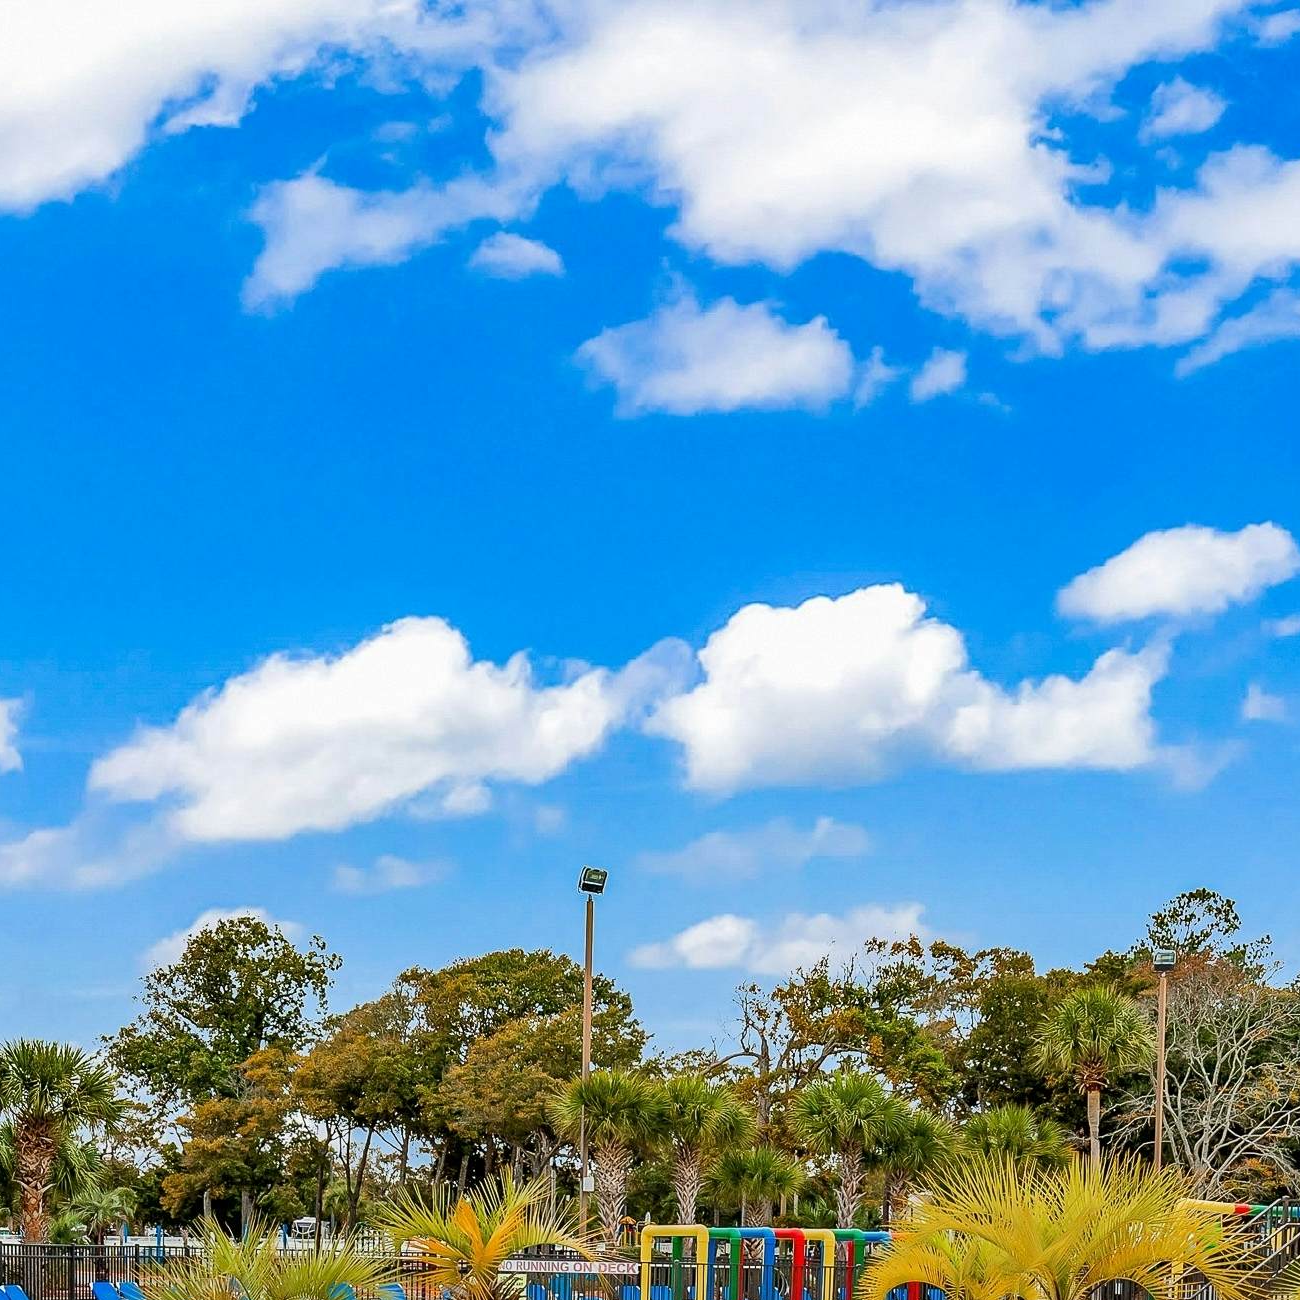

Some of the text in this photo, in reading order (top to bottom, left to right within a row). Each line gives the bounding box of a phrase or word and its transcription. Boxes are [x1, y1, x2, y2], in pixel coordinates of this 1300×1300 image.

[500, 1260, 637, 1274] NO RUNNING ON DECK
